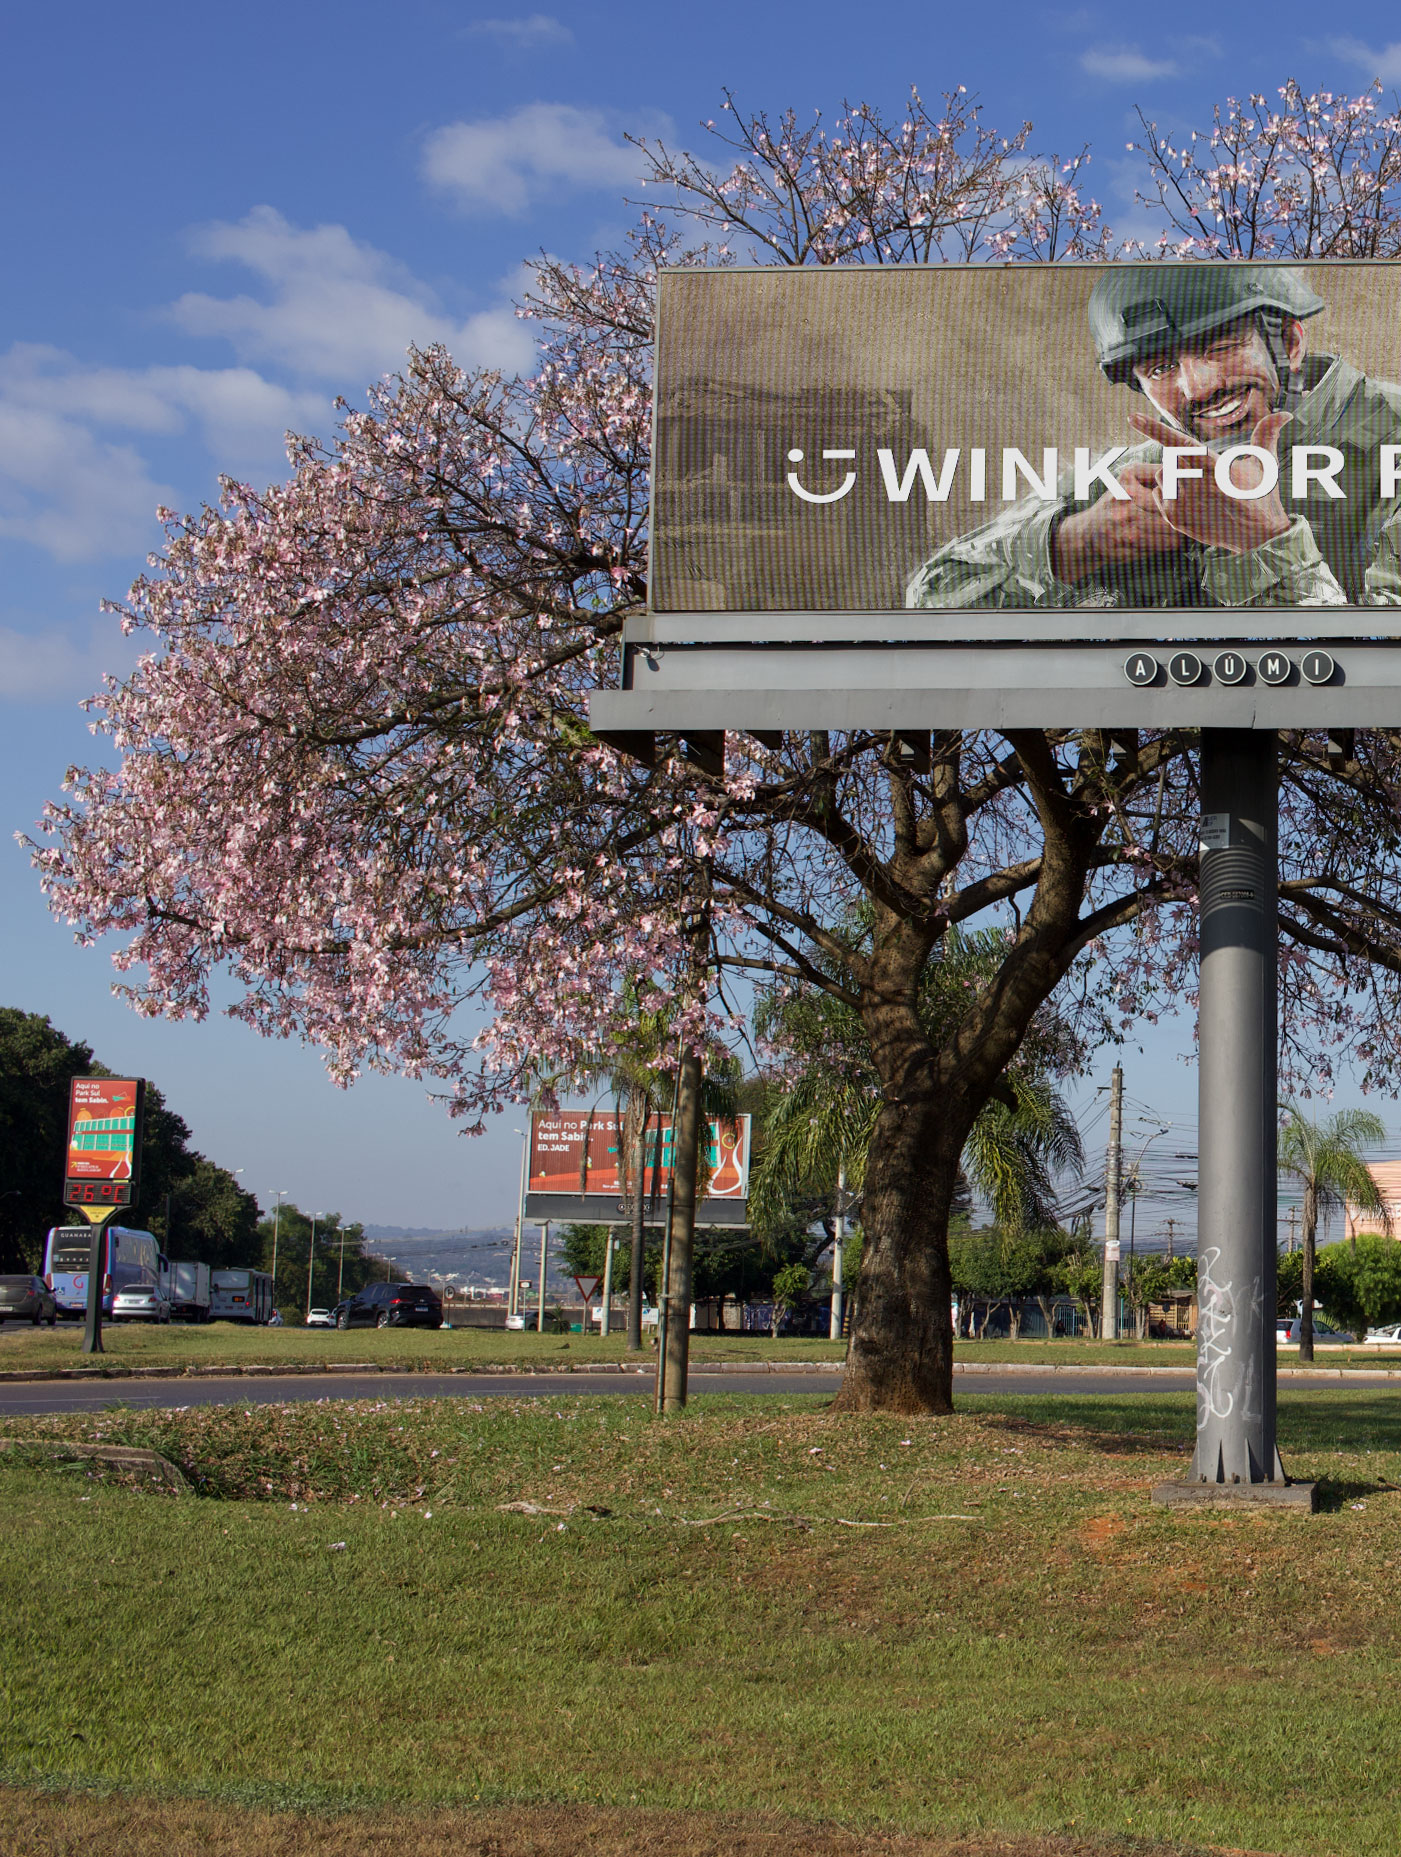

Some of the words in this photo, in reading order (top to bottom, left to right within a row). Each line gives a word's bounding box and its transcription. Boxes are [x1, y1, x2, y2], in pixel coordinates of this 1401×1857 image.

[877, 447, 1131, 502] WINK
[1162, 444, 1347, 501] FOR
[75, 1082, 90, 1090] Aqui
[539, 1120, 562, 1130] Aqui
[538, 1132, 559, 1140] tem
[561, 1131, 594, 1142] Sabi.
[537, 1143, 549, 1151] ED.
[551, 1144, 570, 1152] JADE
[70, 1184, 95, 1202] 26
